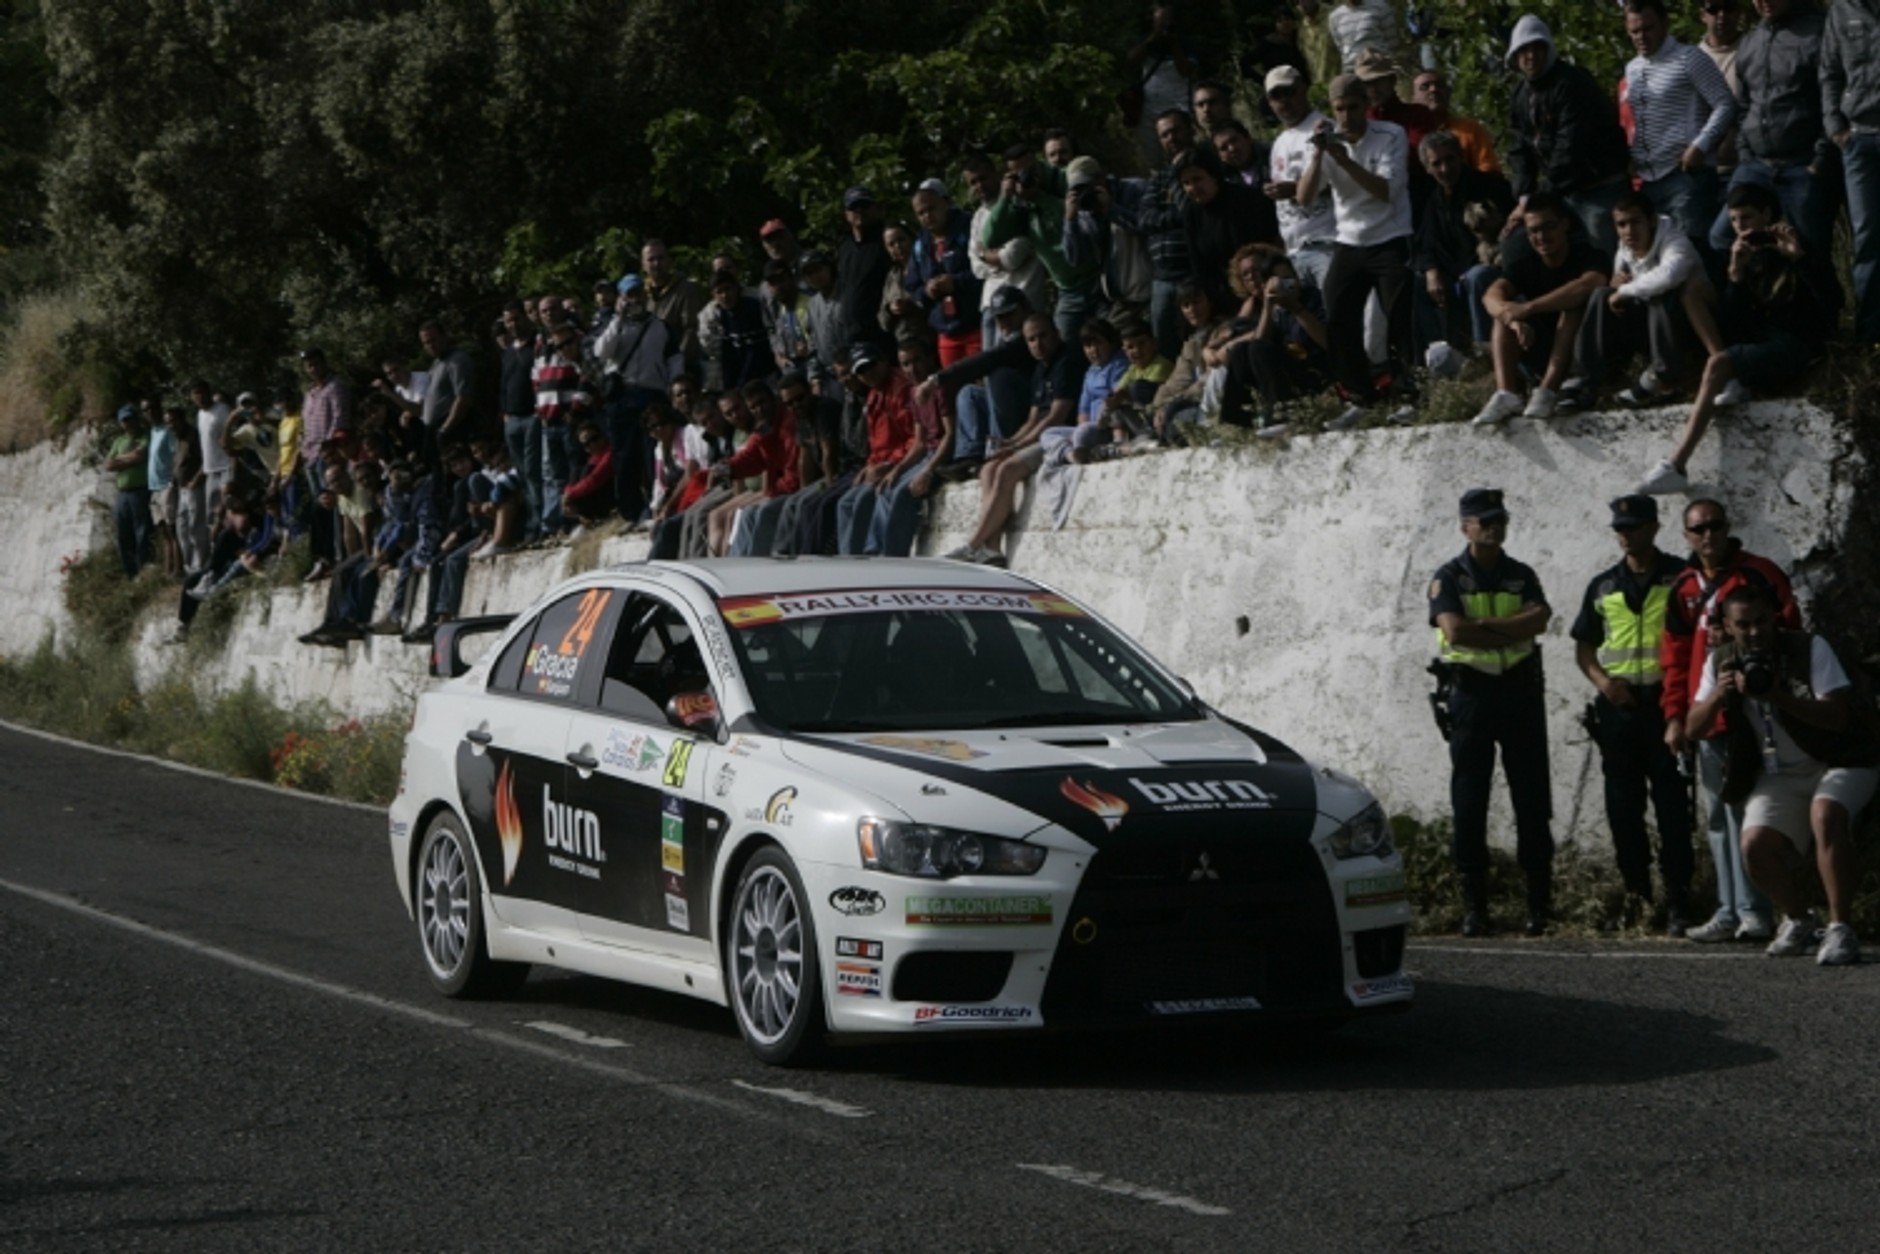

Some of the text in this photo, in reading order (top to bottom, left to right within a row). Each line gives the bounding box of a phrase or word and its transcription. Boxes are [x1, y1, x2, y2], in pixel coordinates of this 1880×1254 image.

[780, 593, 1032, 616] RALLY-IRC.COM
[557, 588, 612, 658] 24
[533, 644, 578, 680] Gracia
[663, 738, 693, 788] 24
[1127, 777, 1269, 804] burn
[543, 782, 601, 862] burn
[915, 1005, 1031, 1019] BFGoodrich
